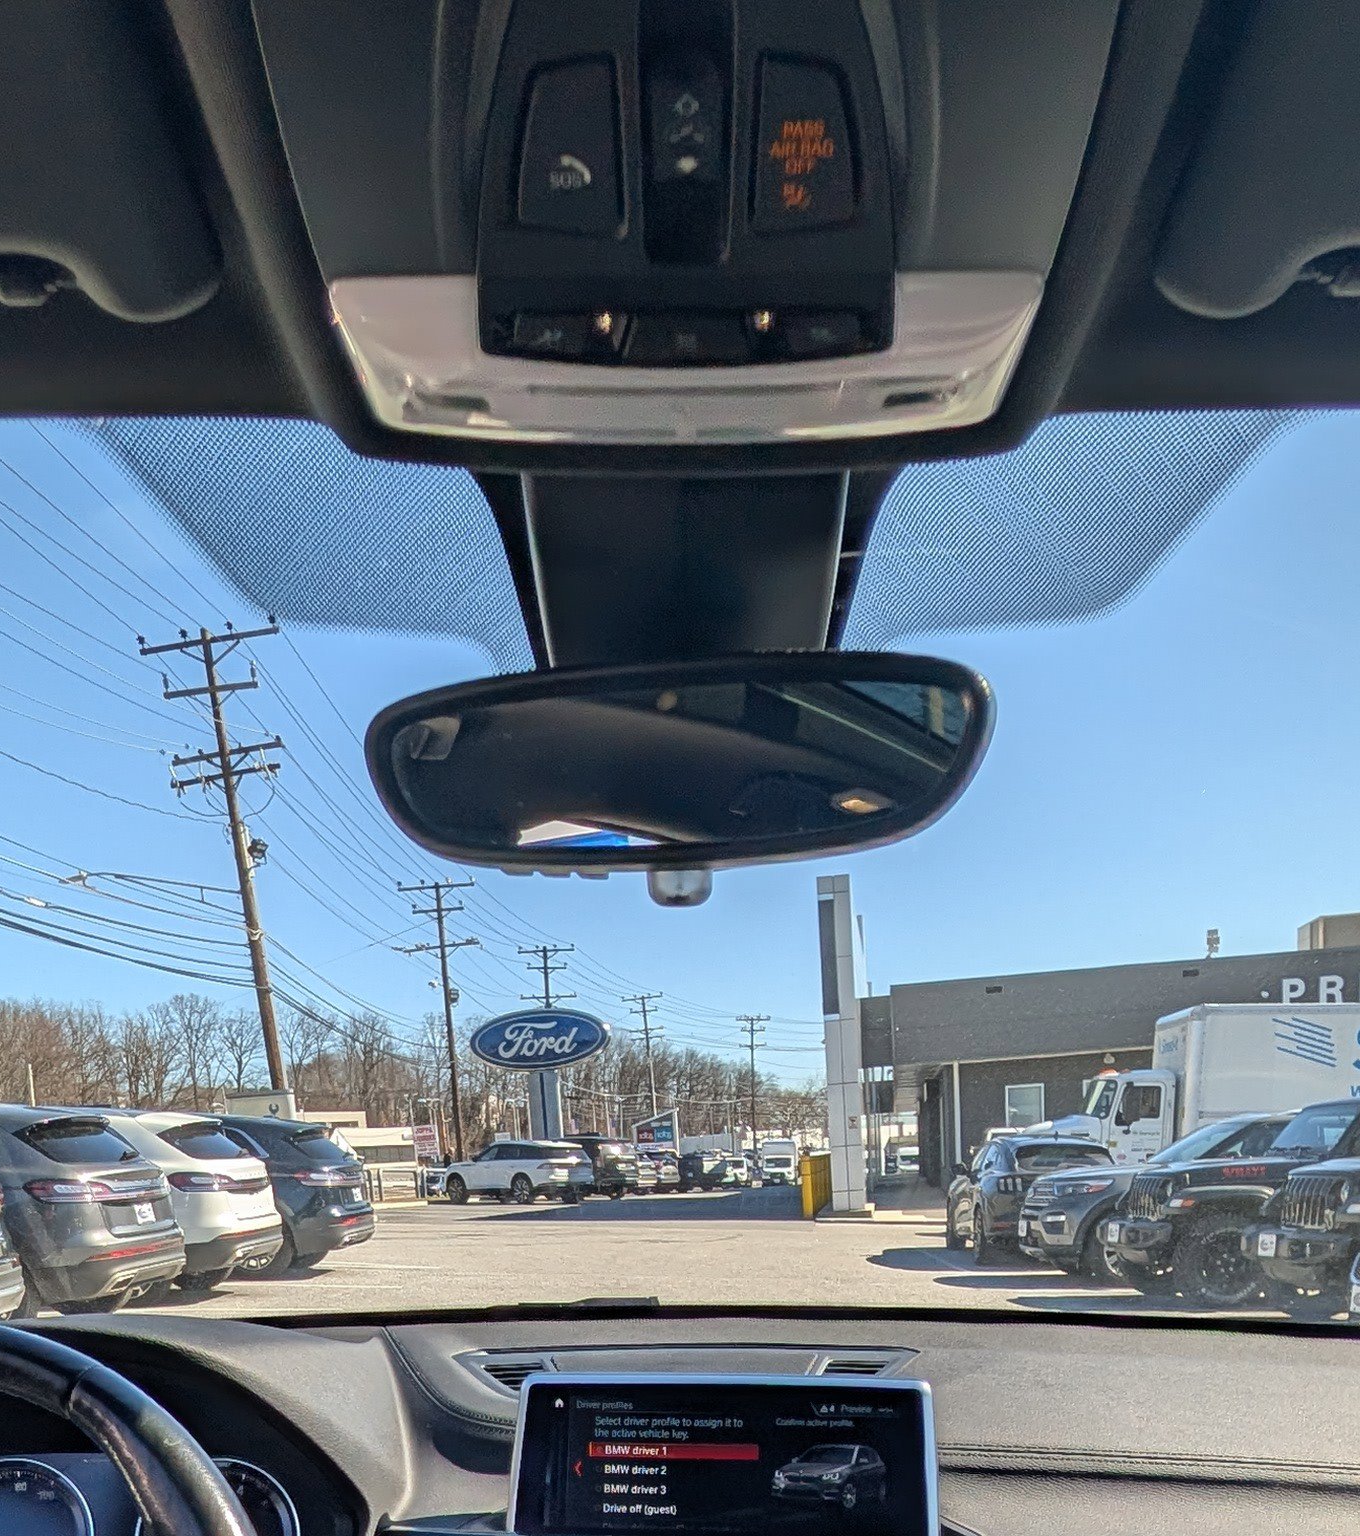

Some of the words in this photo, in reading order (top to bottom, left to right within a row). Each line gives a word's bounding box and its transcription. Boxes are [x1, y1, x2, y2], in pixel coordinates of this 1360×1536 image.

[497, 1021, 579, 1059] Ford
[595, 1416, 622, 1427] Select
[624, 1416, 650, 1428] driver
[651, 1417, 680, 1429] profile
[681, 1419, 691, 1429] to
[693, 1419, 723, 1431] assign
[733, 1419, 744, 1430] to
[594, 1428, 609, 1438] the
[611, 1428, 636, 1439] active
[638, 1429, 669, 1440] vehicle
[671, 1430, 689, 1441] key.
[604, 1445, 630, 1456] BMW
[632, 1445, 660, 1456] driver
[662, 1445, 668, 1456] 1
[604, 1465, 630, 1475] BMW
[631, 1465, 660, 1476] driver
[660, 1466, 668, 1476] 2
[603, 1484, 629, 1495] BMW
[630, 1484, 658, 1495] driver
[659, 1485, 668, 1495] 3
[602, 1503, 628, 1514] Drive
[629, 1503, 642, 1514] off
[643, 1503, 678, 1516] (guest)
